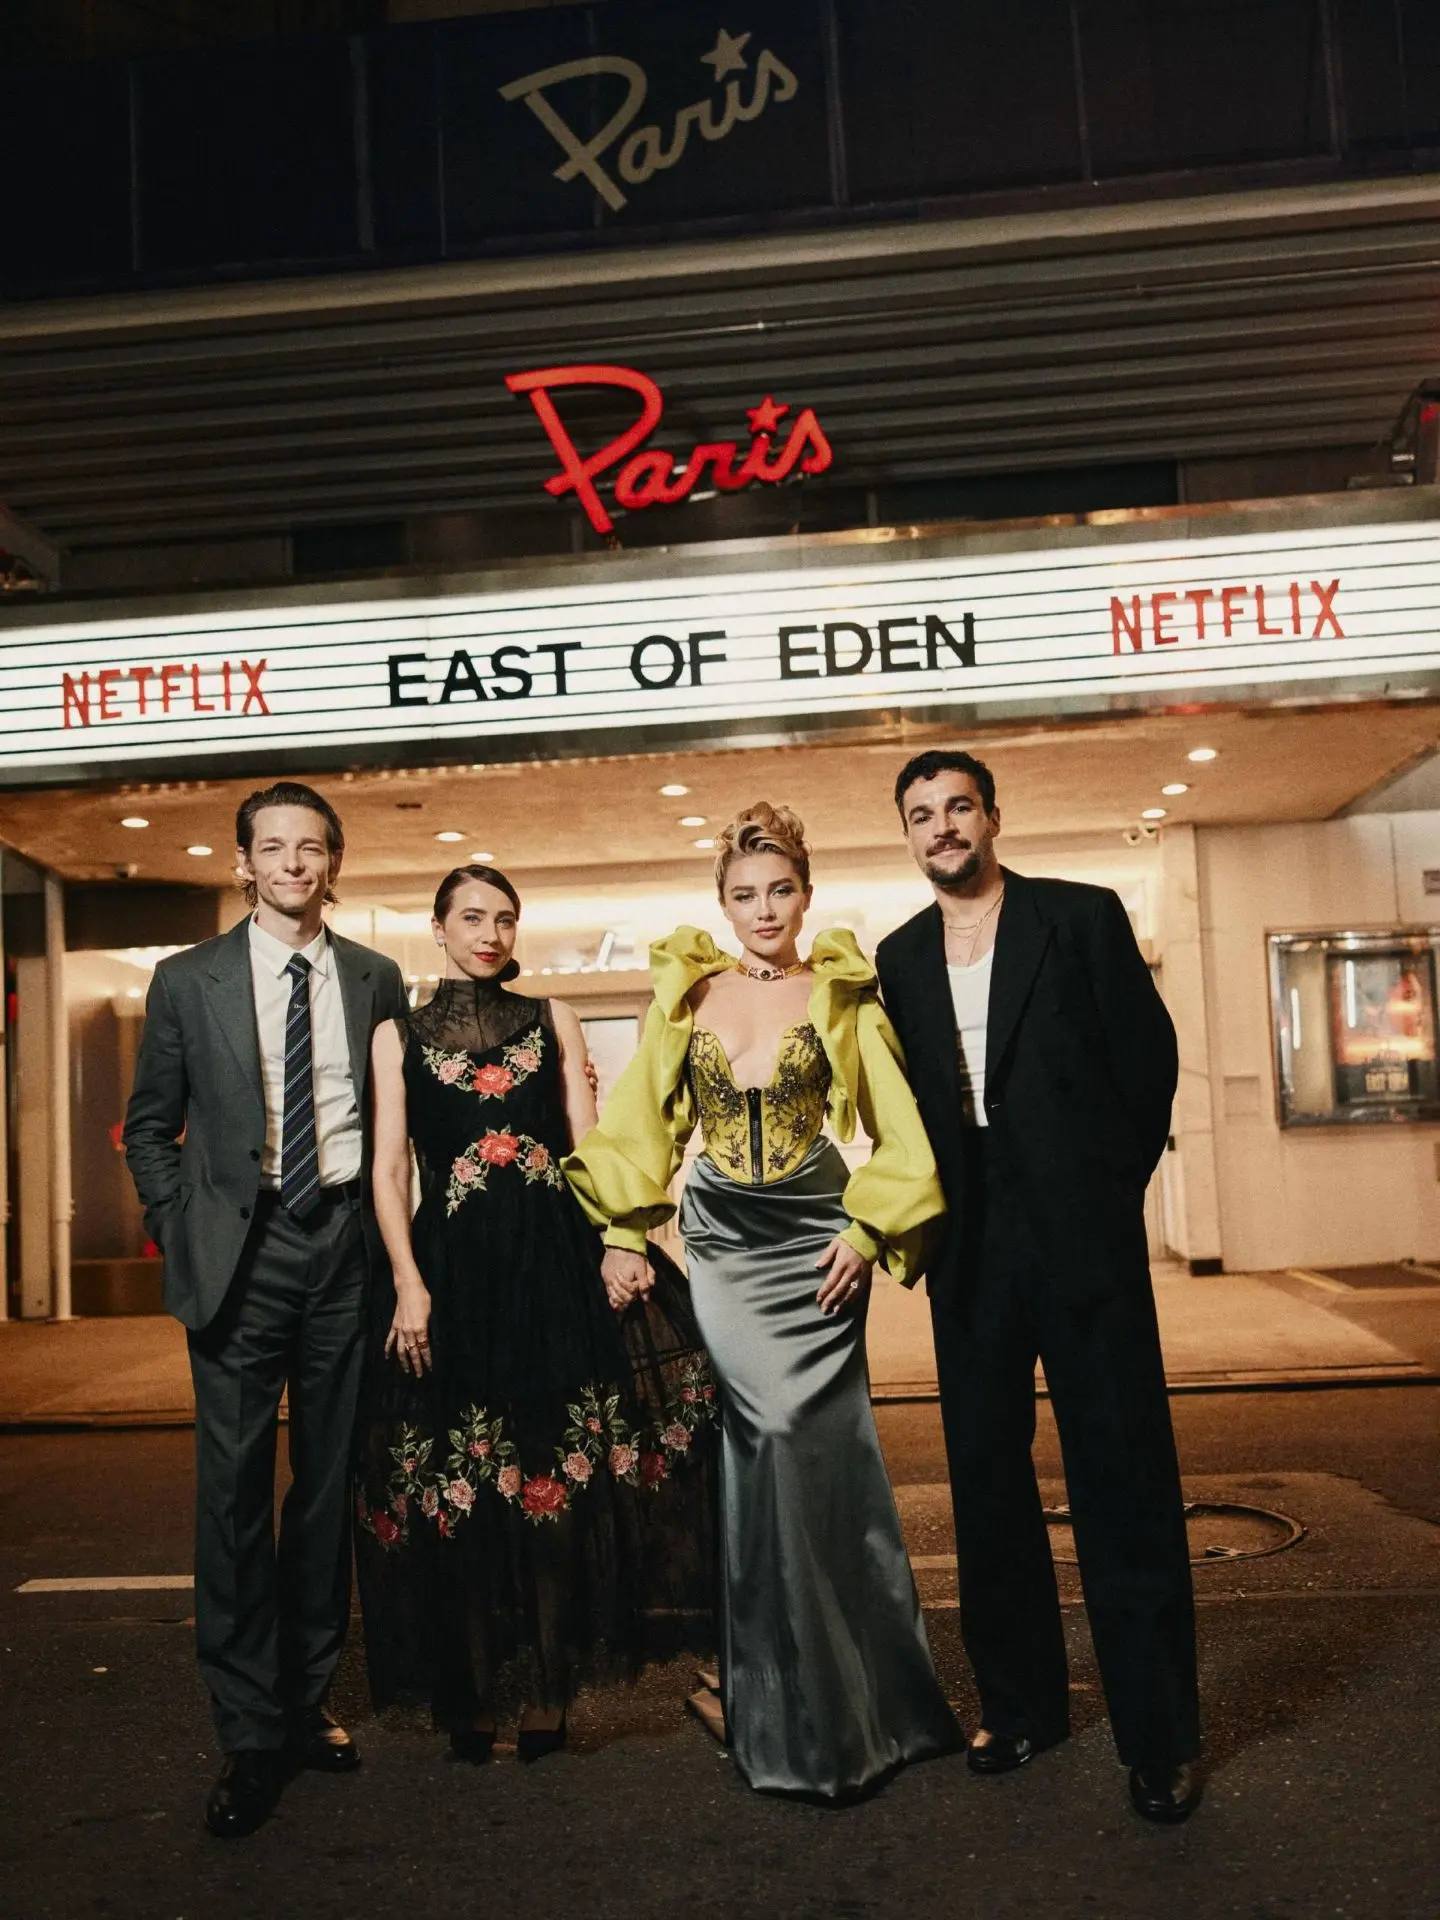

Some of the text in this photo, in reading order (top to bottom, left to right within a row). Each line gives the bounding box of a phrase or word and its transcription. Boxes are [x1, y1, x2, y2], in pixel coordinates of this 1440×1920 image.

[498, 28, 799, 212] Paris
[505, 365, 834, 534] Paris
[387, 612, 977, 708] EAST OF EDEN
[1110, 579, 1345, 657] NETFLIX
[62, 658, 271, 730] NETFLIX
